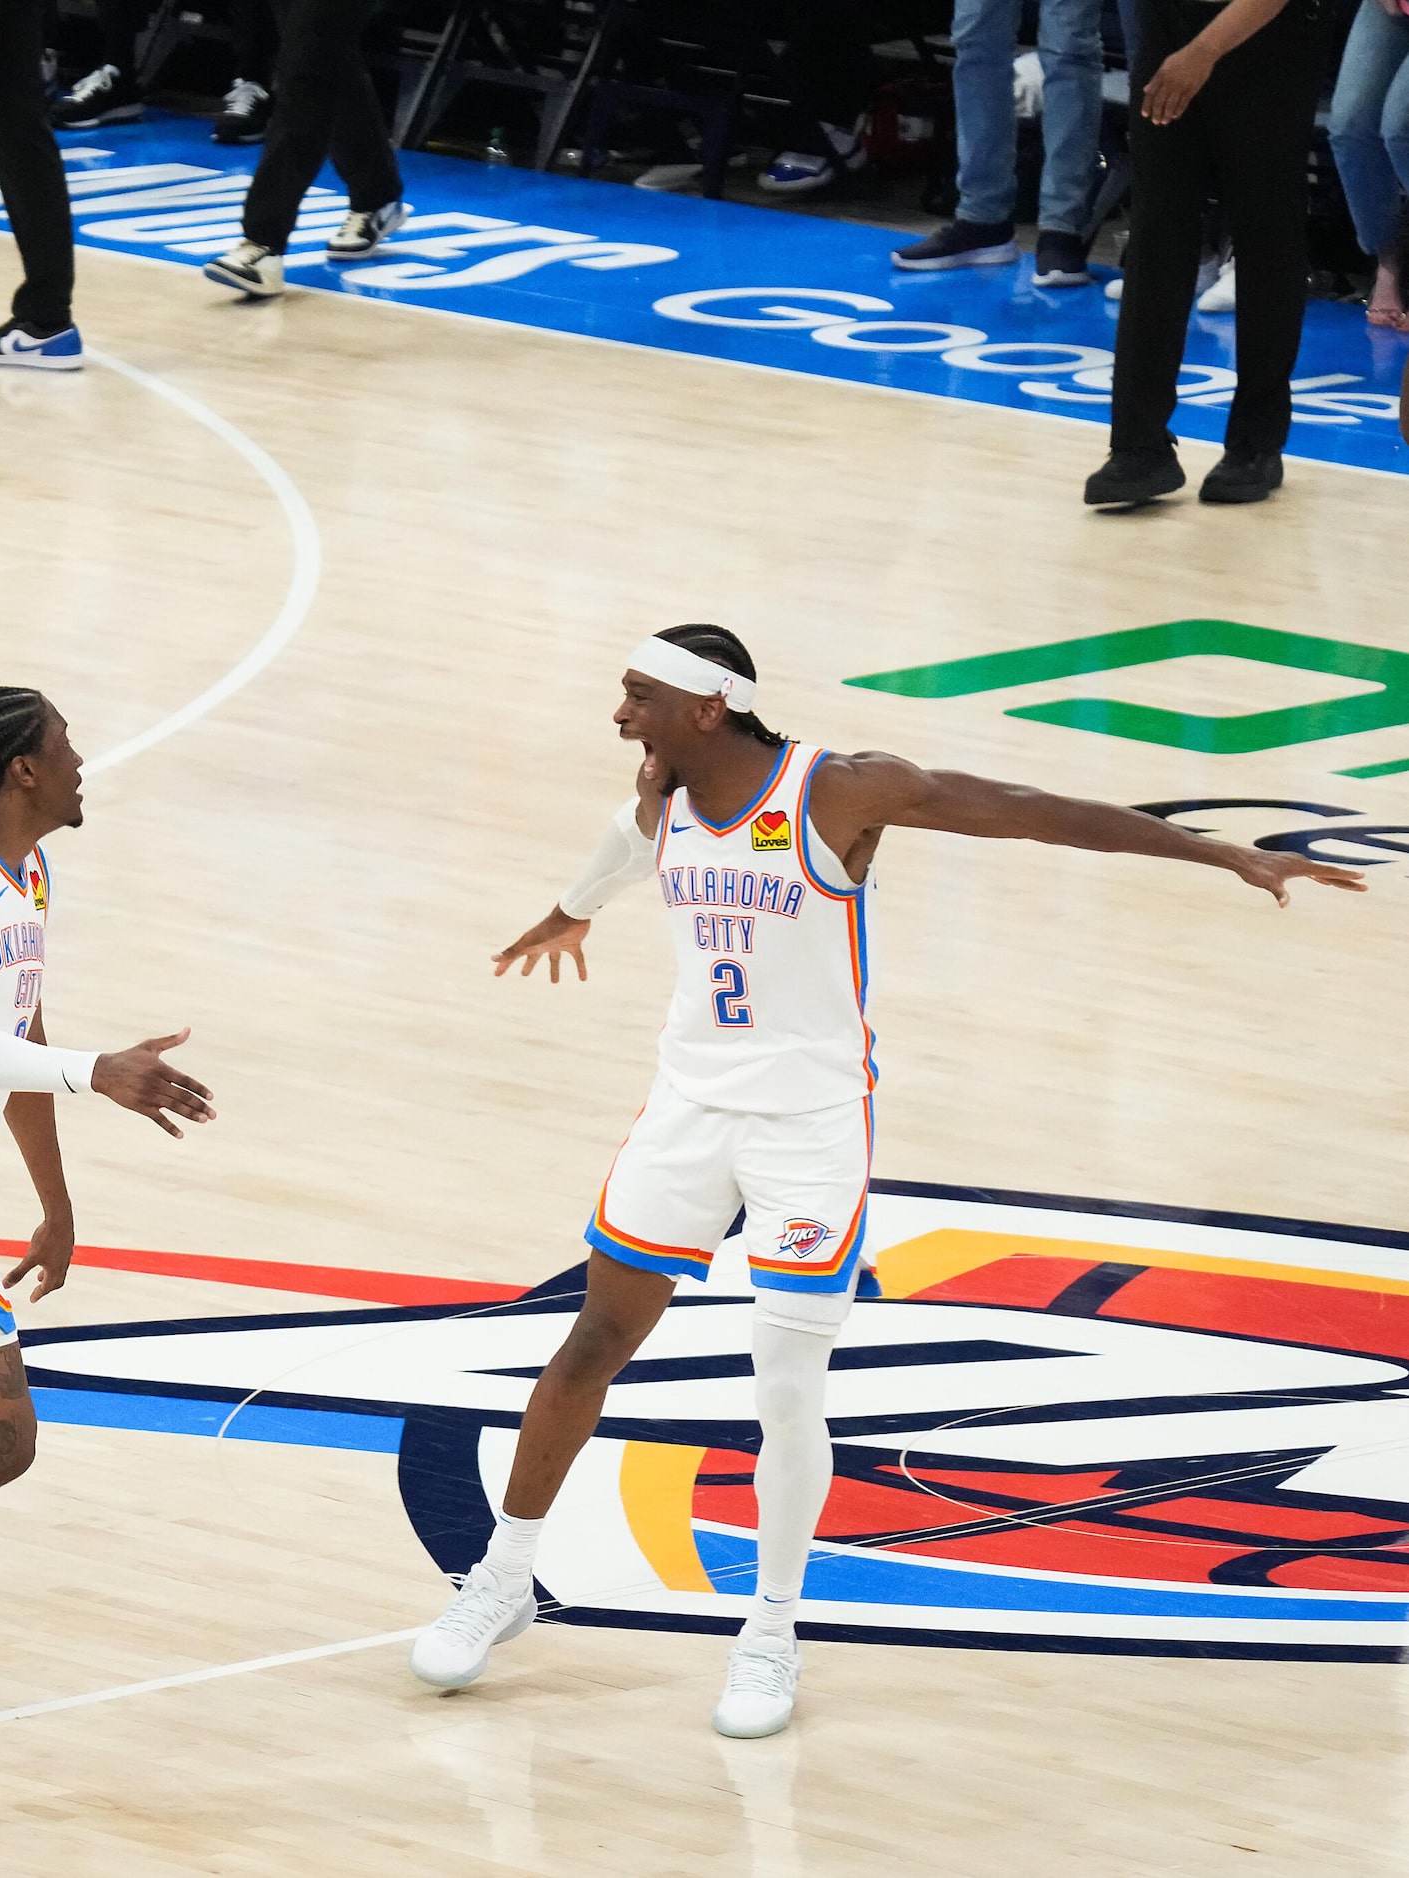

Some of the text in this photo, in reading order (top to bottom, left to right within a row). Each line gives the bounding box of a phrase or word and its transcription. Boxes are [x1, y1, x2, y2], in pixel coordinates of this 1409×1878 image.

[755, 836, 788, 848] Love's
[659, 866, 806, 919] OKLAHOMA
[693, 912, 755, 953] CITY
[711, 958, 754, 1028] 2
[780, 1226, 819, 1250] OKC
